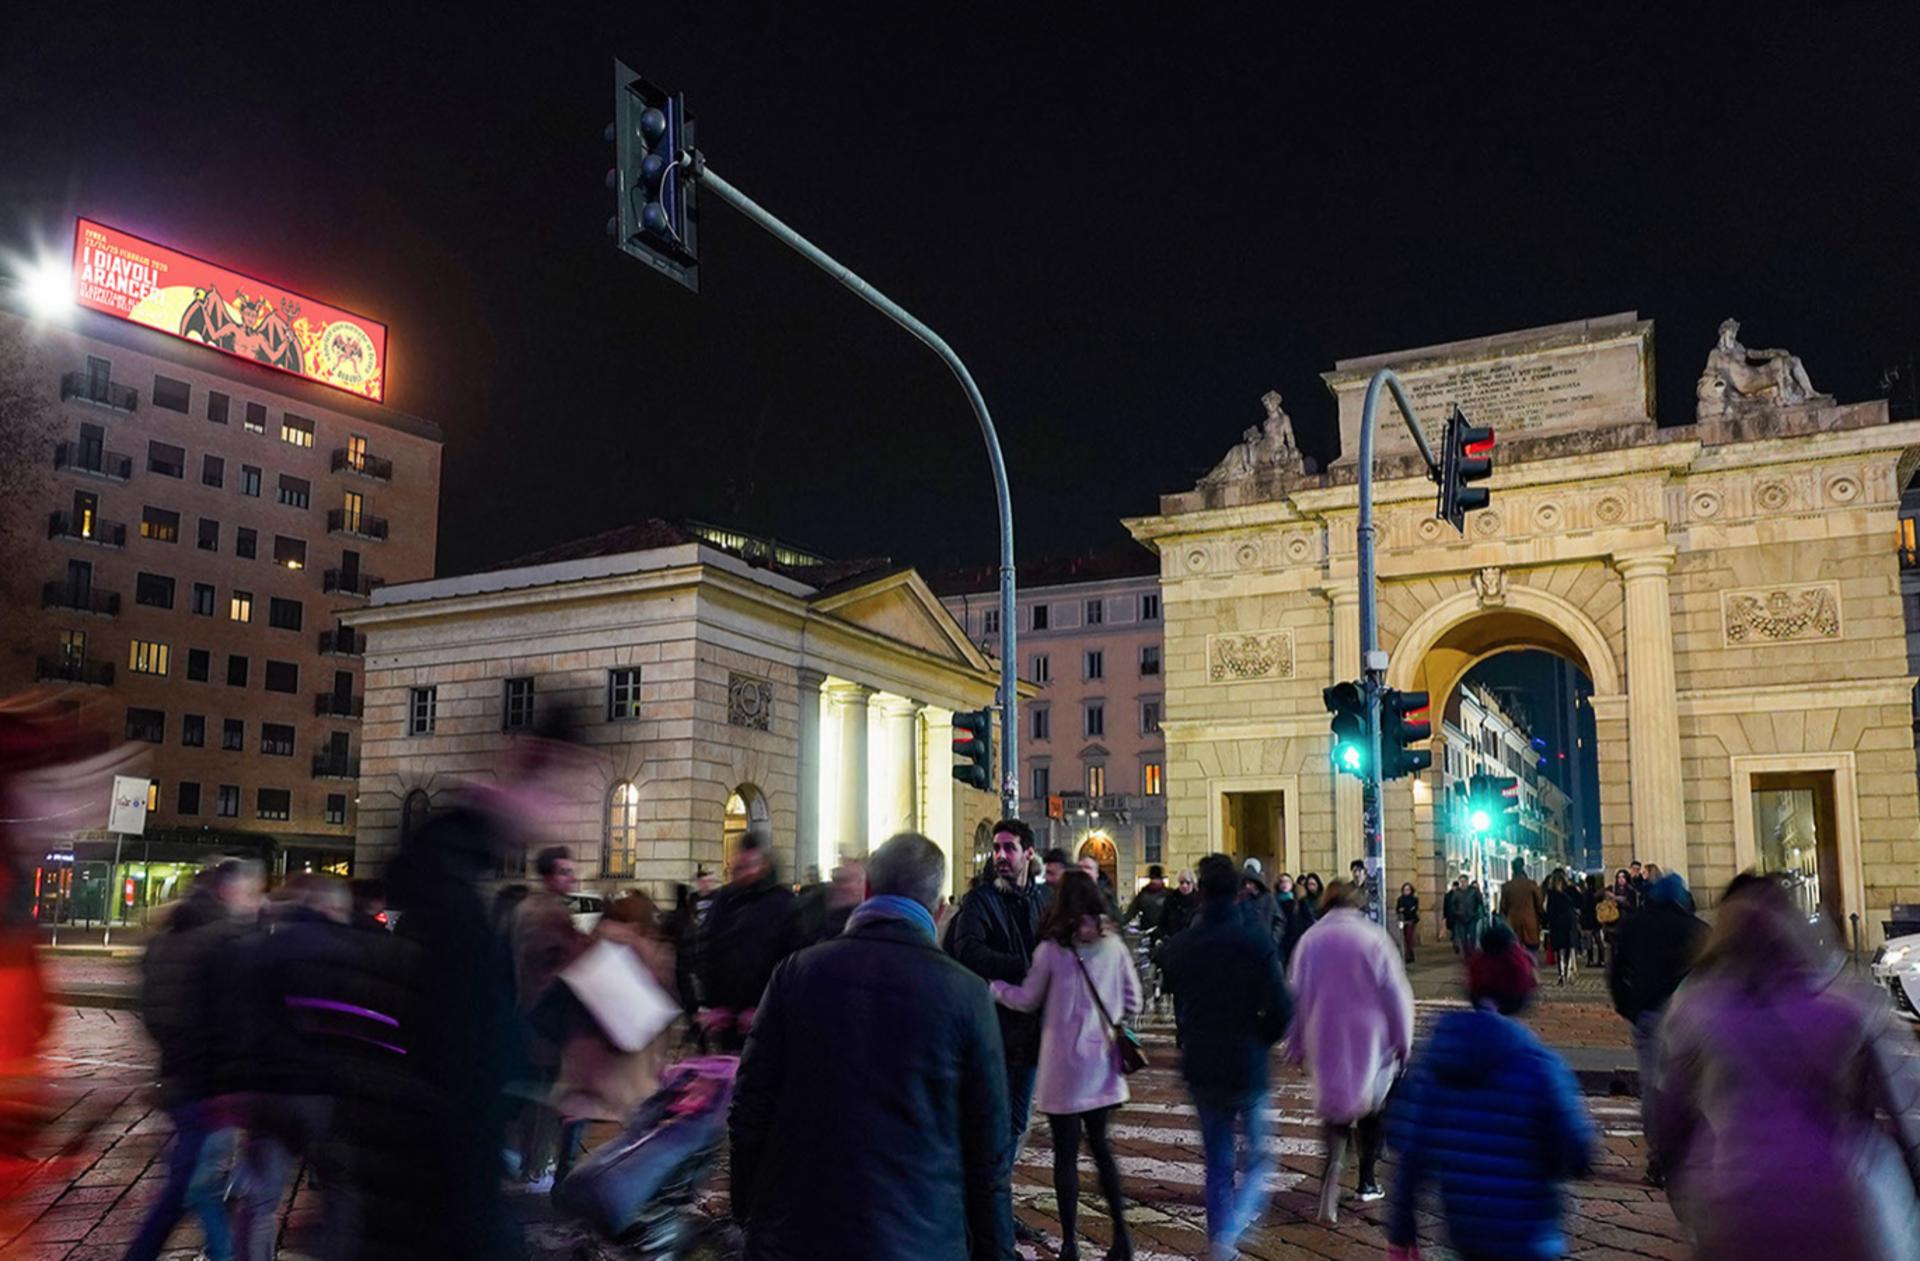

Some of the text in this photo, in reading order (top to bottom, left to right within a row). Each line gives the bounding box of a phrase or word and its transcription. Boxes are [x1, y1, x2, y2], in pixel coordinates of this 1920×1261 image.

[81, 264, 166, 305] ARANCERI
[84, 246, 158, 288] I DIAVOLI
